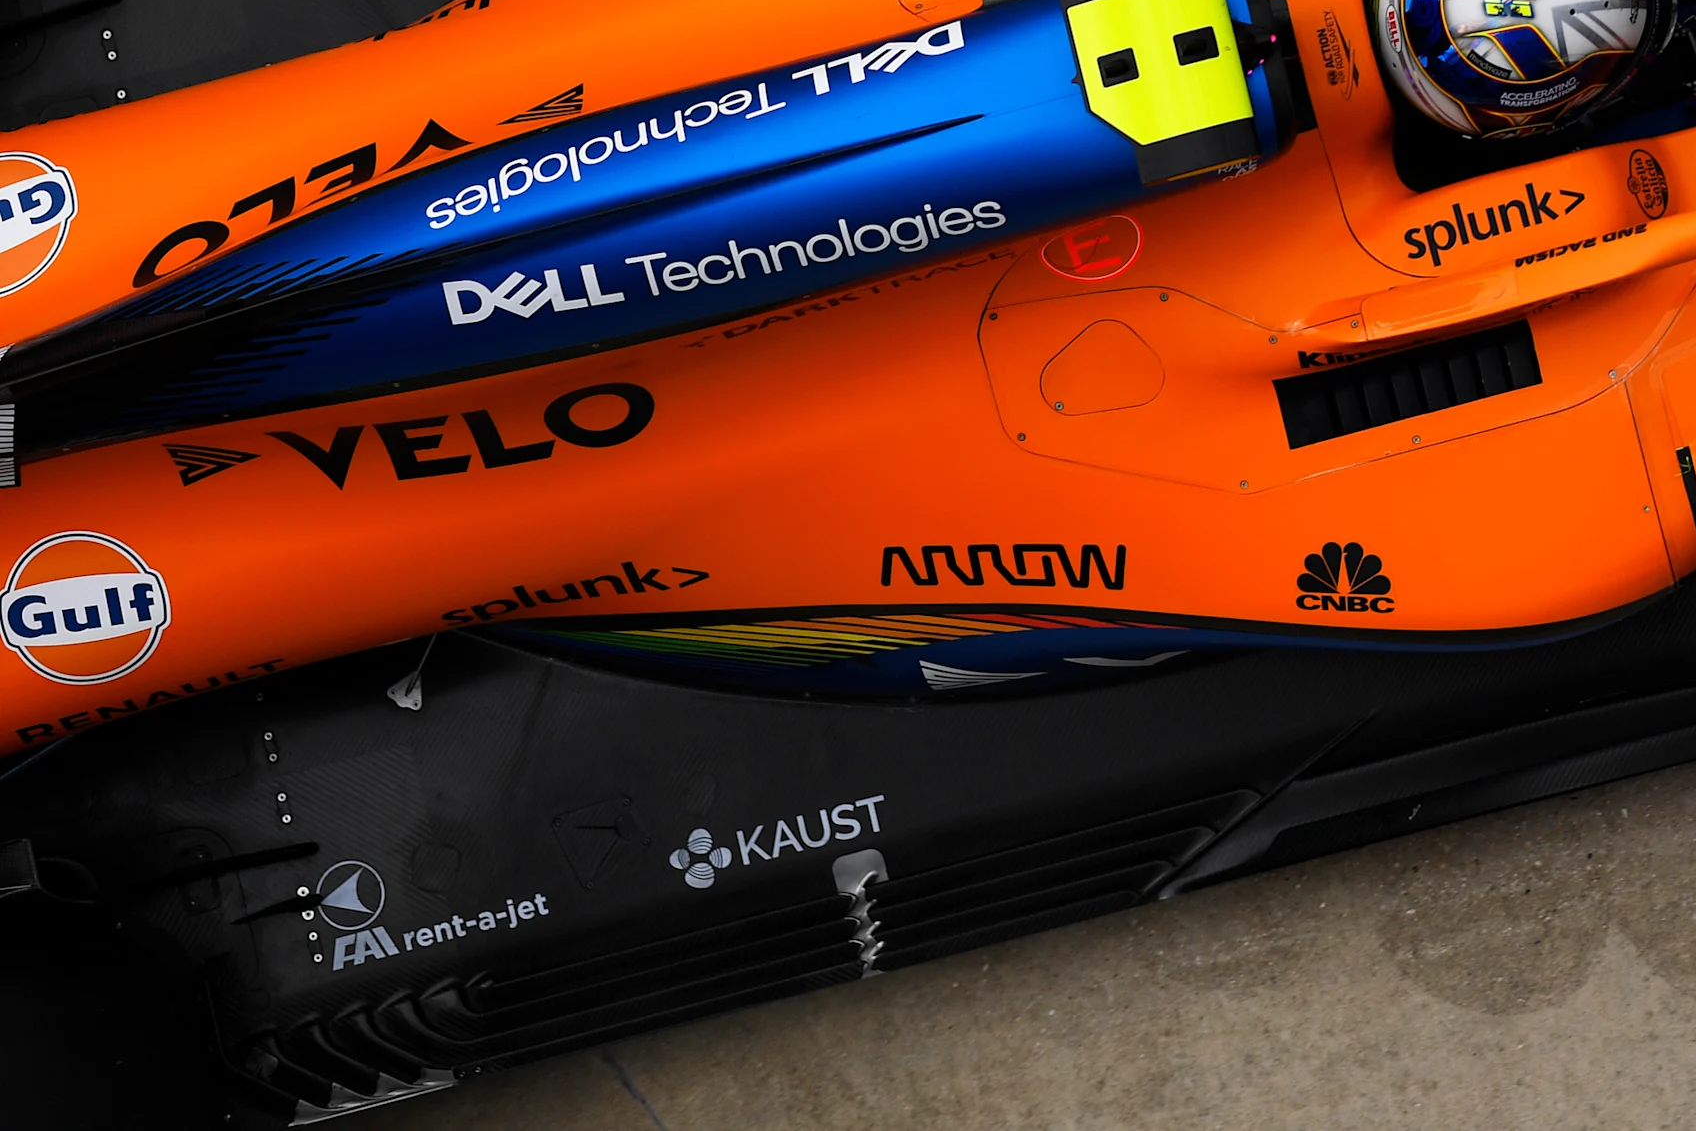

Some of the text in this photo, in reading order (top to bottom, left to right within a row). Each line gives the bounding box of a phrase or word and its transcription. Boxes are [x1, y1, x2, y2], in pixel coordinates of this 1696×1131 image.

[1317, 28, 1335, 68] ACTION
[1324, 11, 1338, 43] SAFETY
[1388, 11, 1400, 47] BELL
[1332, 44, 1344, 70] ROAD
[1501, 77, 1578, 101] ACCELERATING
[1501, 84, 1578, 108] TRANSFORMATION
[425, 20, 964, 229] DELL Technologies
[132, 119, 474, 288] VELO
[442, 200, 1007, 326] DELL Technologies
[1515, 222, 1647, 268] END RACISM
[722, 248, 1016, 340] DARKTRACE
[265, 382, 655, 490] VELO
[7, 583, 156, 638] Gulf
[1295, 594, 1395, 614] CNBC
[15, 658, 284, 744] RENAULT
[736, 794, 887, 865] KAUST
[333, 892, 550, 971] FAI rent-a-jet
